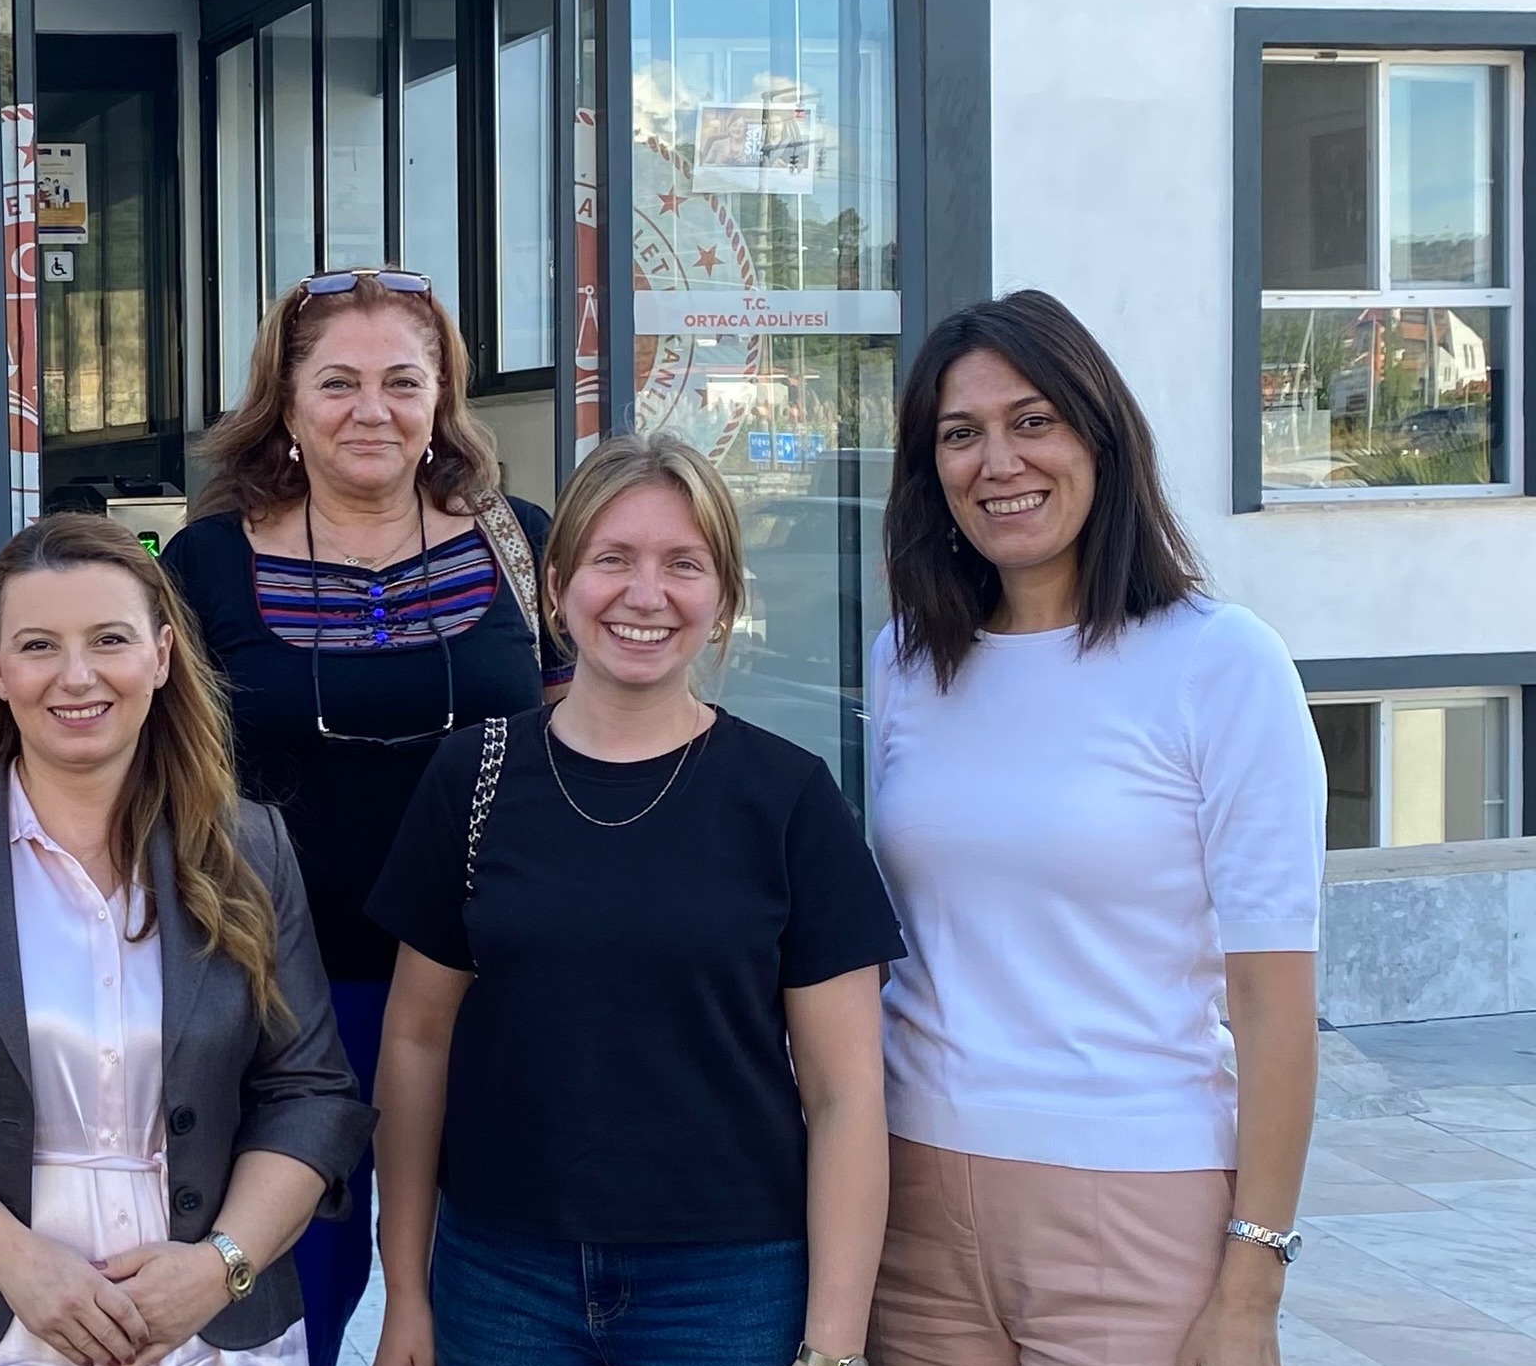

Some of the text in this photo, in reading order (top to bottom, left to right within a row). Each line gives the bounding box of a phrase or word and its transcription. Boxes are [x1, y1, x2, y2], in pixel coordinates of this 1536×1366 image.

[742, 297, 771, 311] T.C.
[684, 310, 829, 327] ORTACA ADLİYESİ
